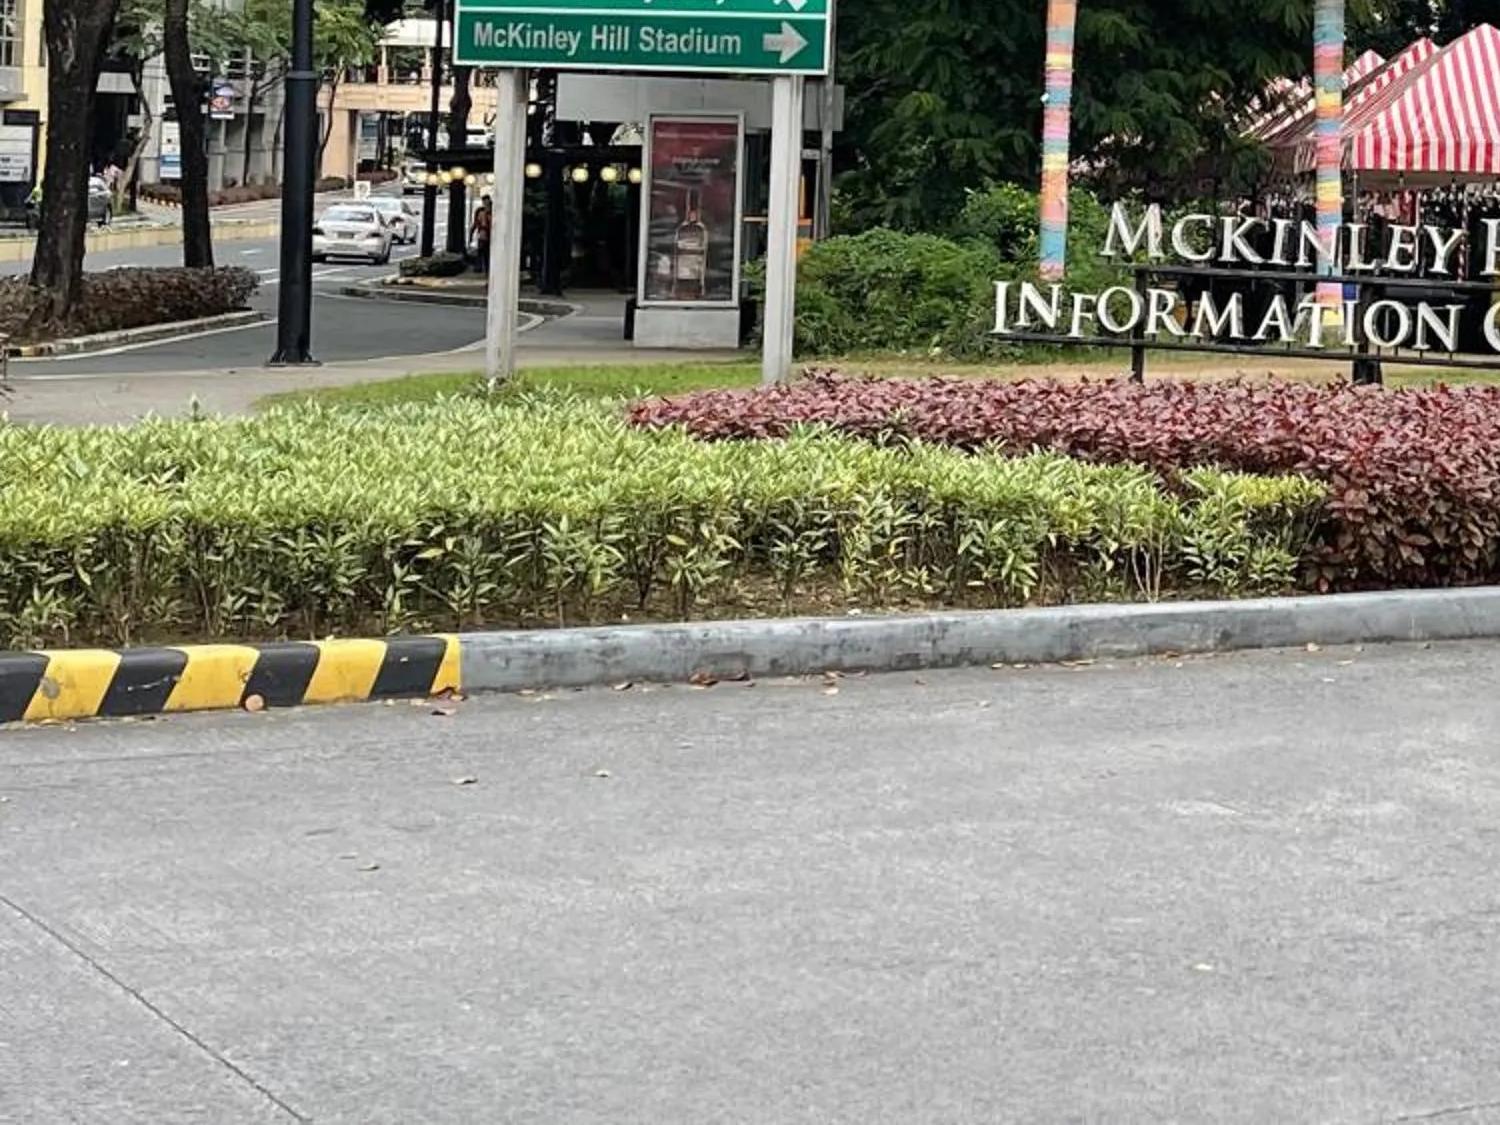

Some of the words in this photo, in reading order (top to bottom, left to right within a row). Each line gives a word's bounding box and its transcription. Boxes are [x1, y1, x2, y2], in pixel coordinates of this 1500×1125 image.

[473, 22, 581, 56] McKinley
[590, 24, 630, 51] Hill
[638, 26, 742, 55] Stadium
[989, 280, 1466, 353] INFORMATION
